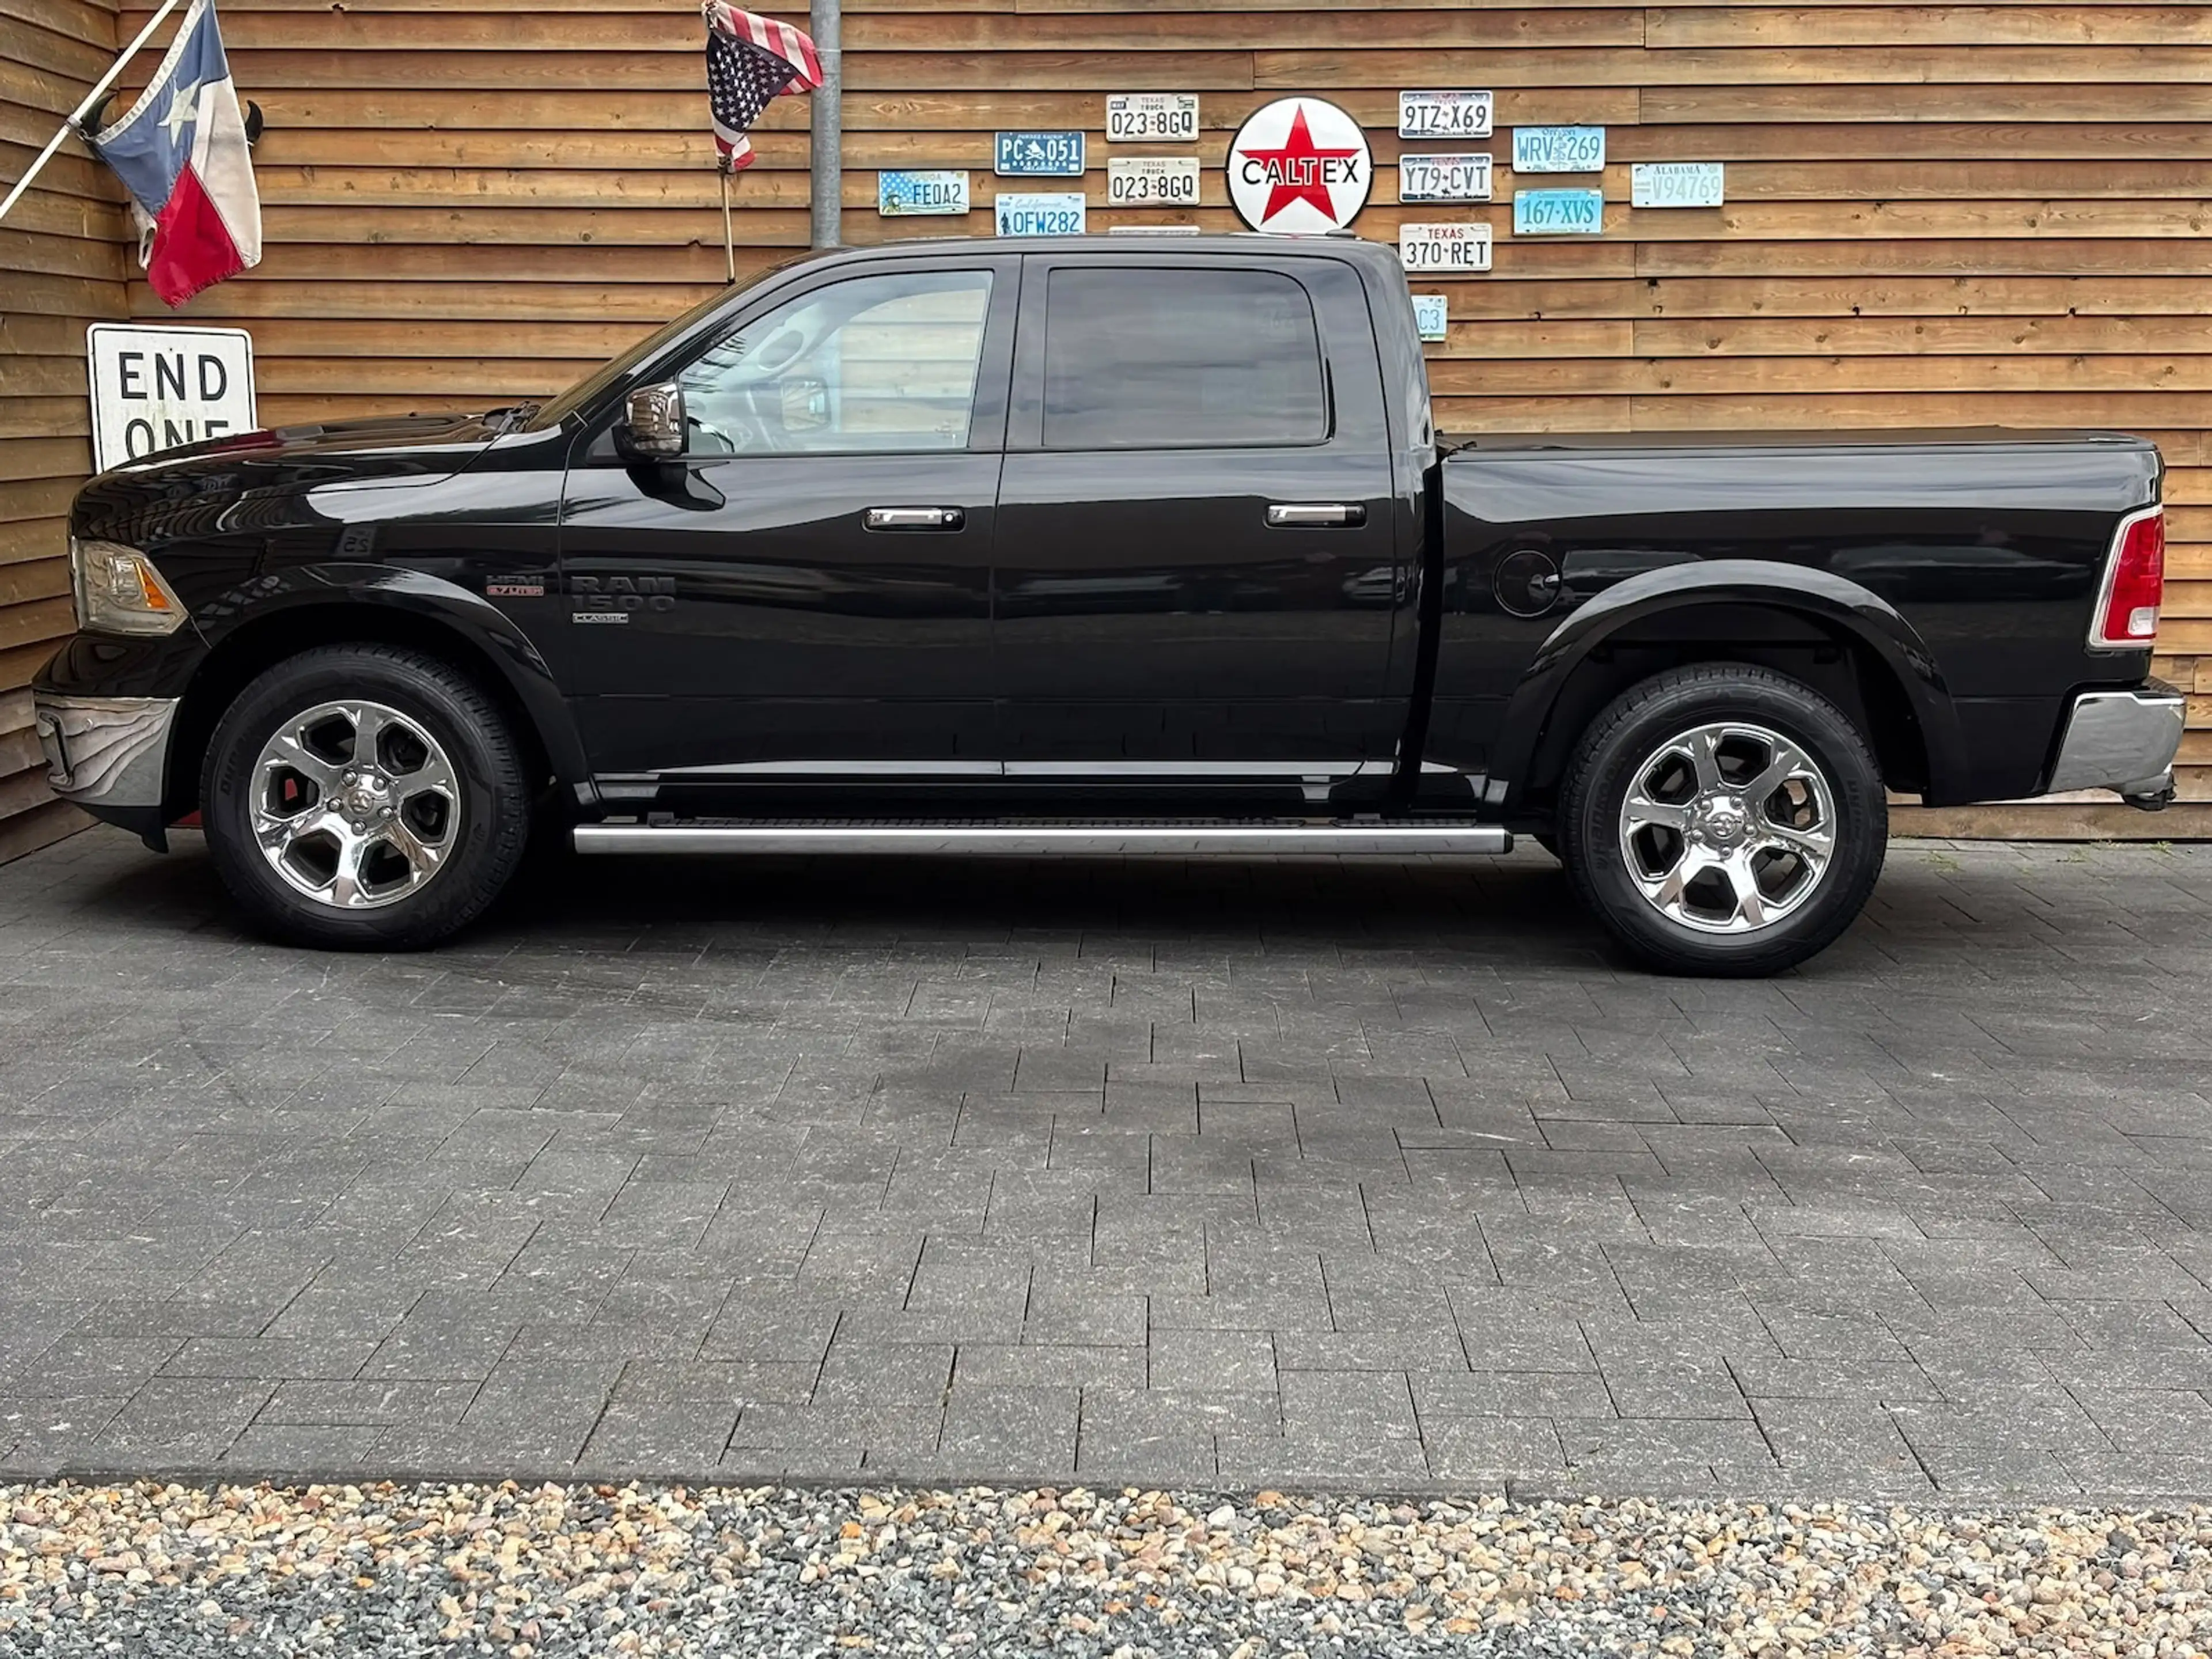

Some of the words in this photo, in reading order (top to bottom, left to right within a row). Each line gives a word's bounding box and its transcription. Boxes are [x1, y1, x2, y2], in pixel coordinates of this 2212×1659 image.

[1002, 139, 1024, 160] PC
[1242, 158, 1359, 185] CALTEX
[1653, 176, 1721, 200] V94769
[1428, 228, 1464, 240] TEXAS
[119, 352, 227, 401] END
[571, 576, 676, 593] RAM
[572, 594, 675, 612] 1500
